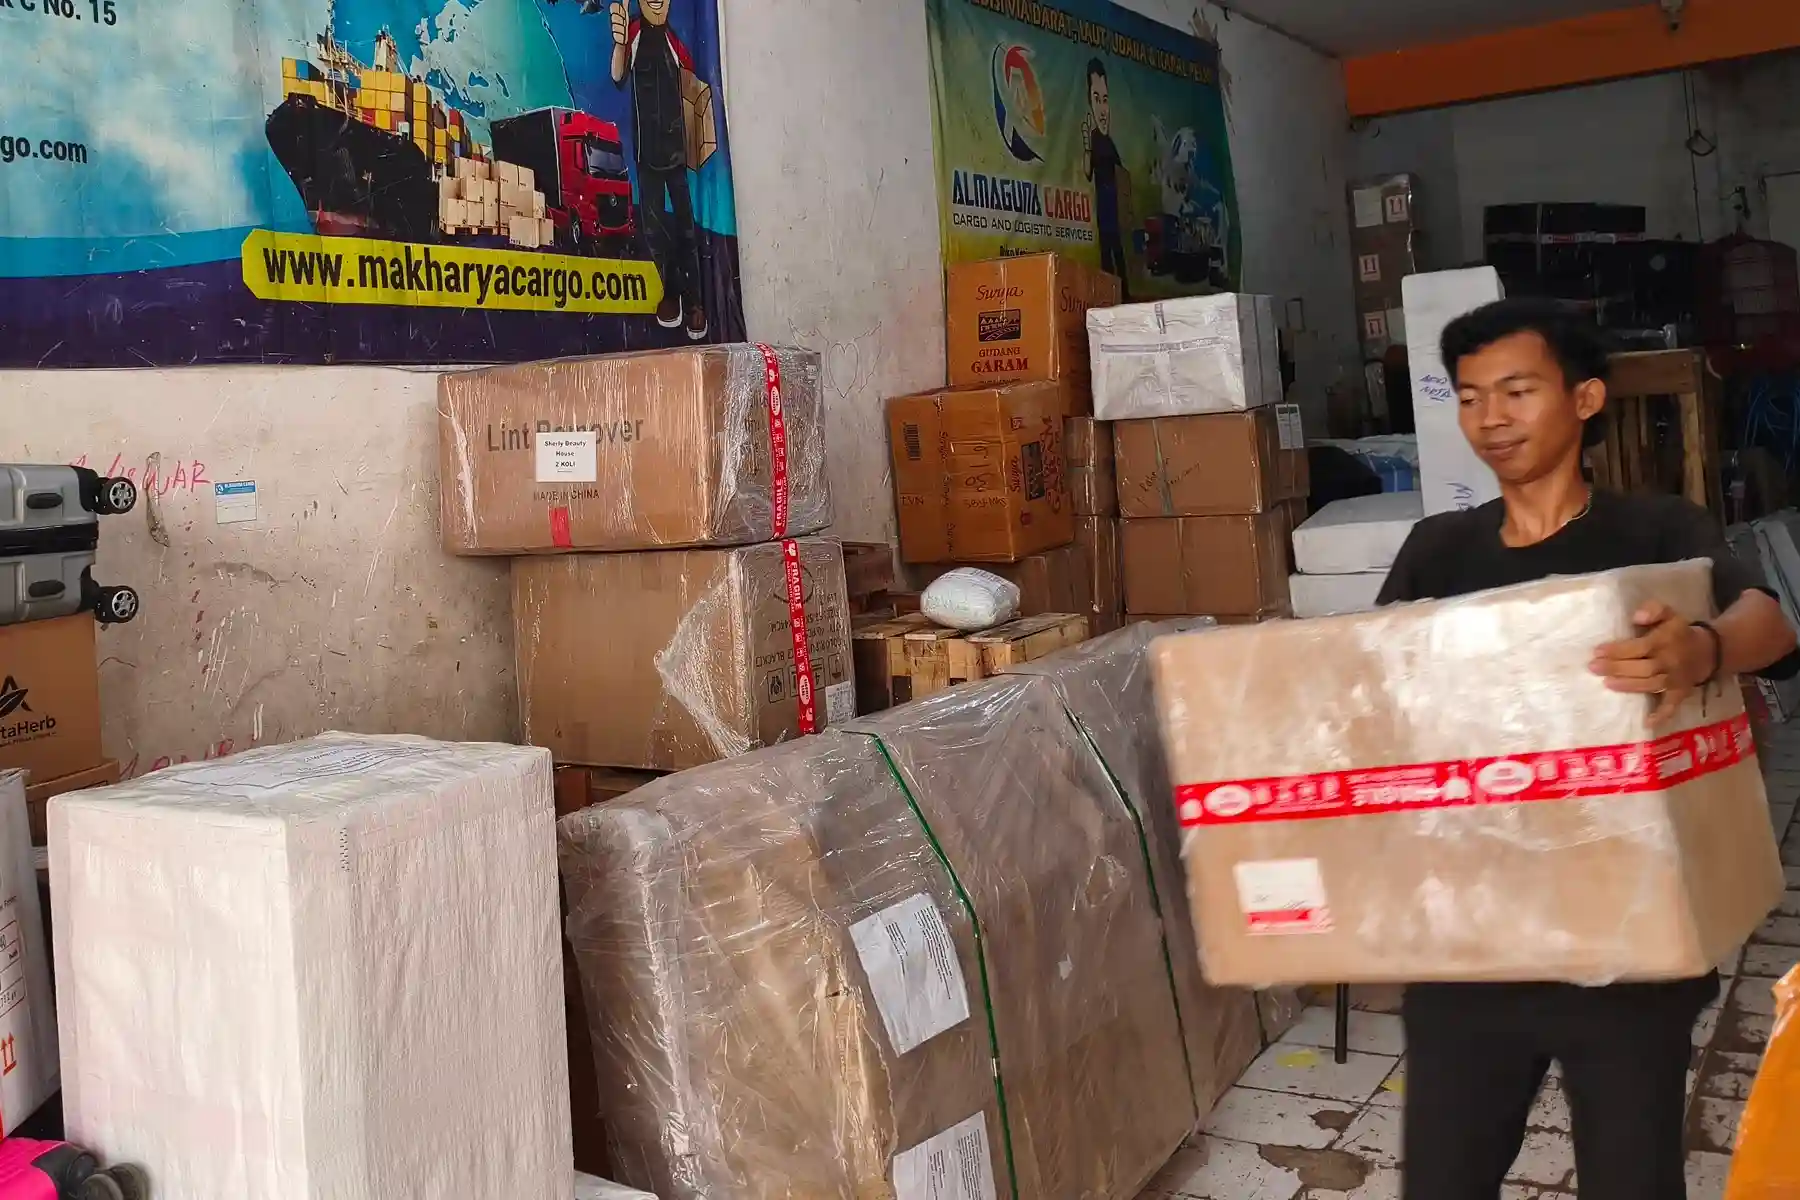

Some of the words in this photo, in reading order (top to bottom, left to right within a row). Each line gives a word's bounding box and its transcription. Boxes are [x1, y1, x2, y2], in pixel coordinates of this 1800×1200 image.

[89, 0, 117, 26] 15
[1044, 186, 1092, 222] CARGO
[953, 213, 987, 228] CARGO
[991, 218, 1012, 231] AND
[1014, 221, 1052, 236] LOGISTIC
[1055, 227, 1093, 241] SERVICES
[263, 245, 648, 308] www.makharyacargo.com
[976, 284, 1023, 302] Surya
[971, 357, 1029, 374] GARAM
[979, 347, 1021, 358] GUDANG
[487, 422, 530, 452] Lint
[571, 489, 600, 499] CHINA
[775, 478, 783, 527] FRAGILE
[791, 561, 802, 609] FRAGILE
[762, 651, 785, 665] BLACK
